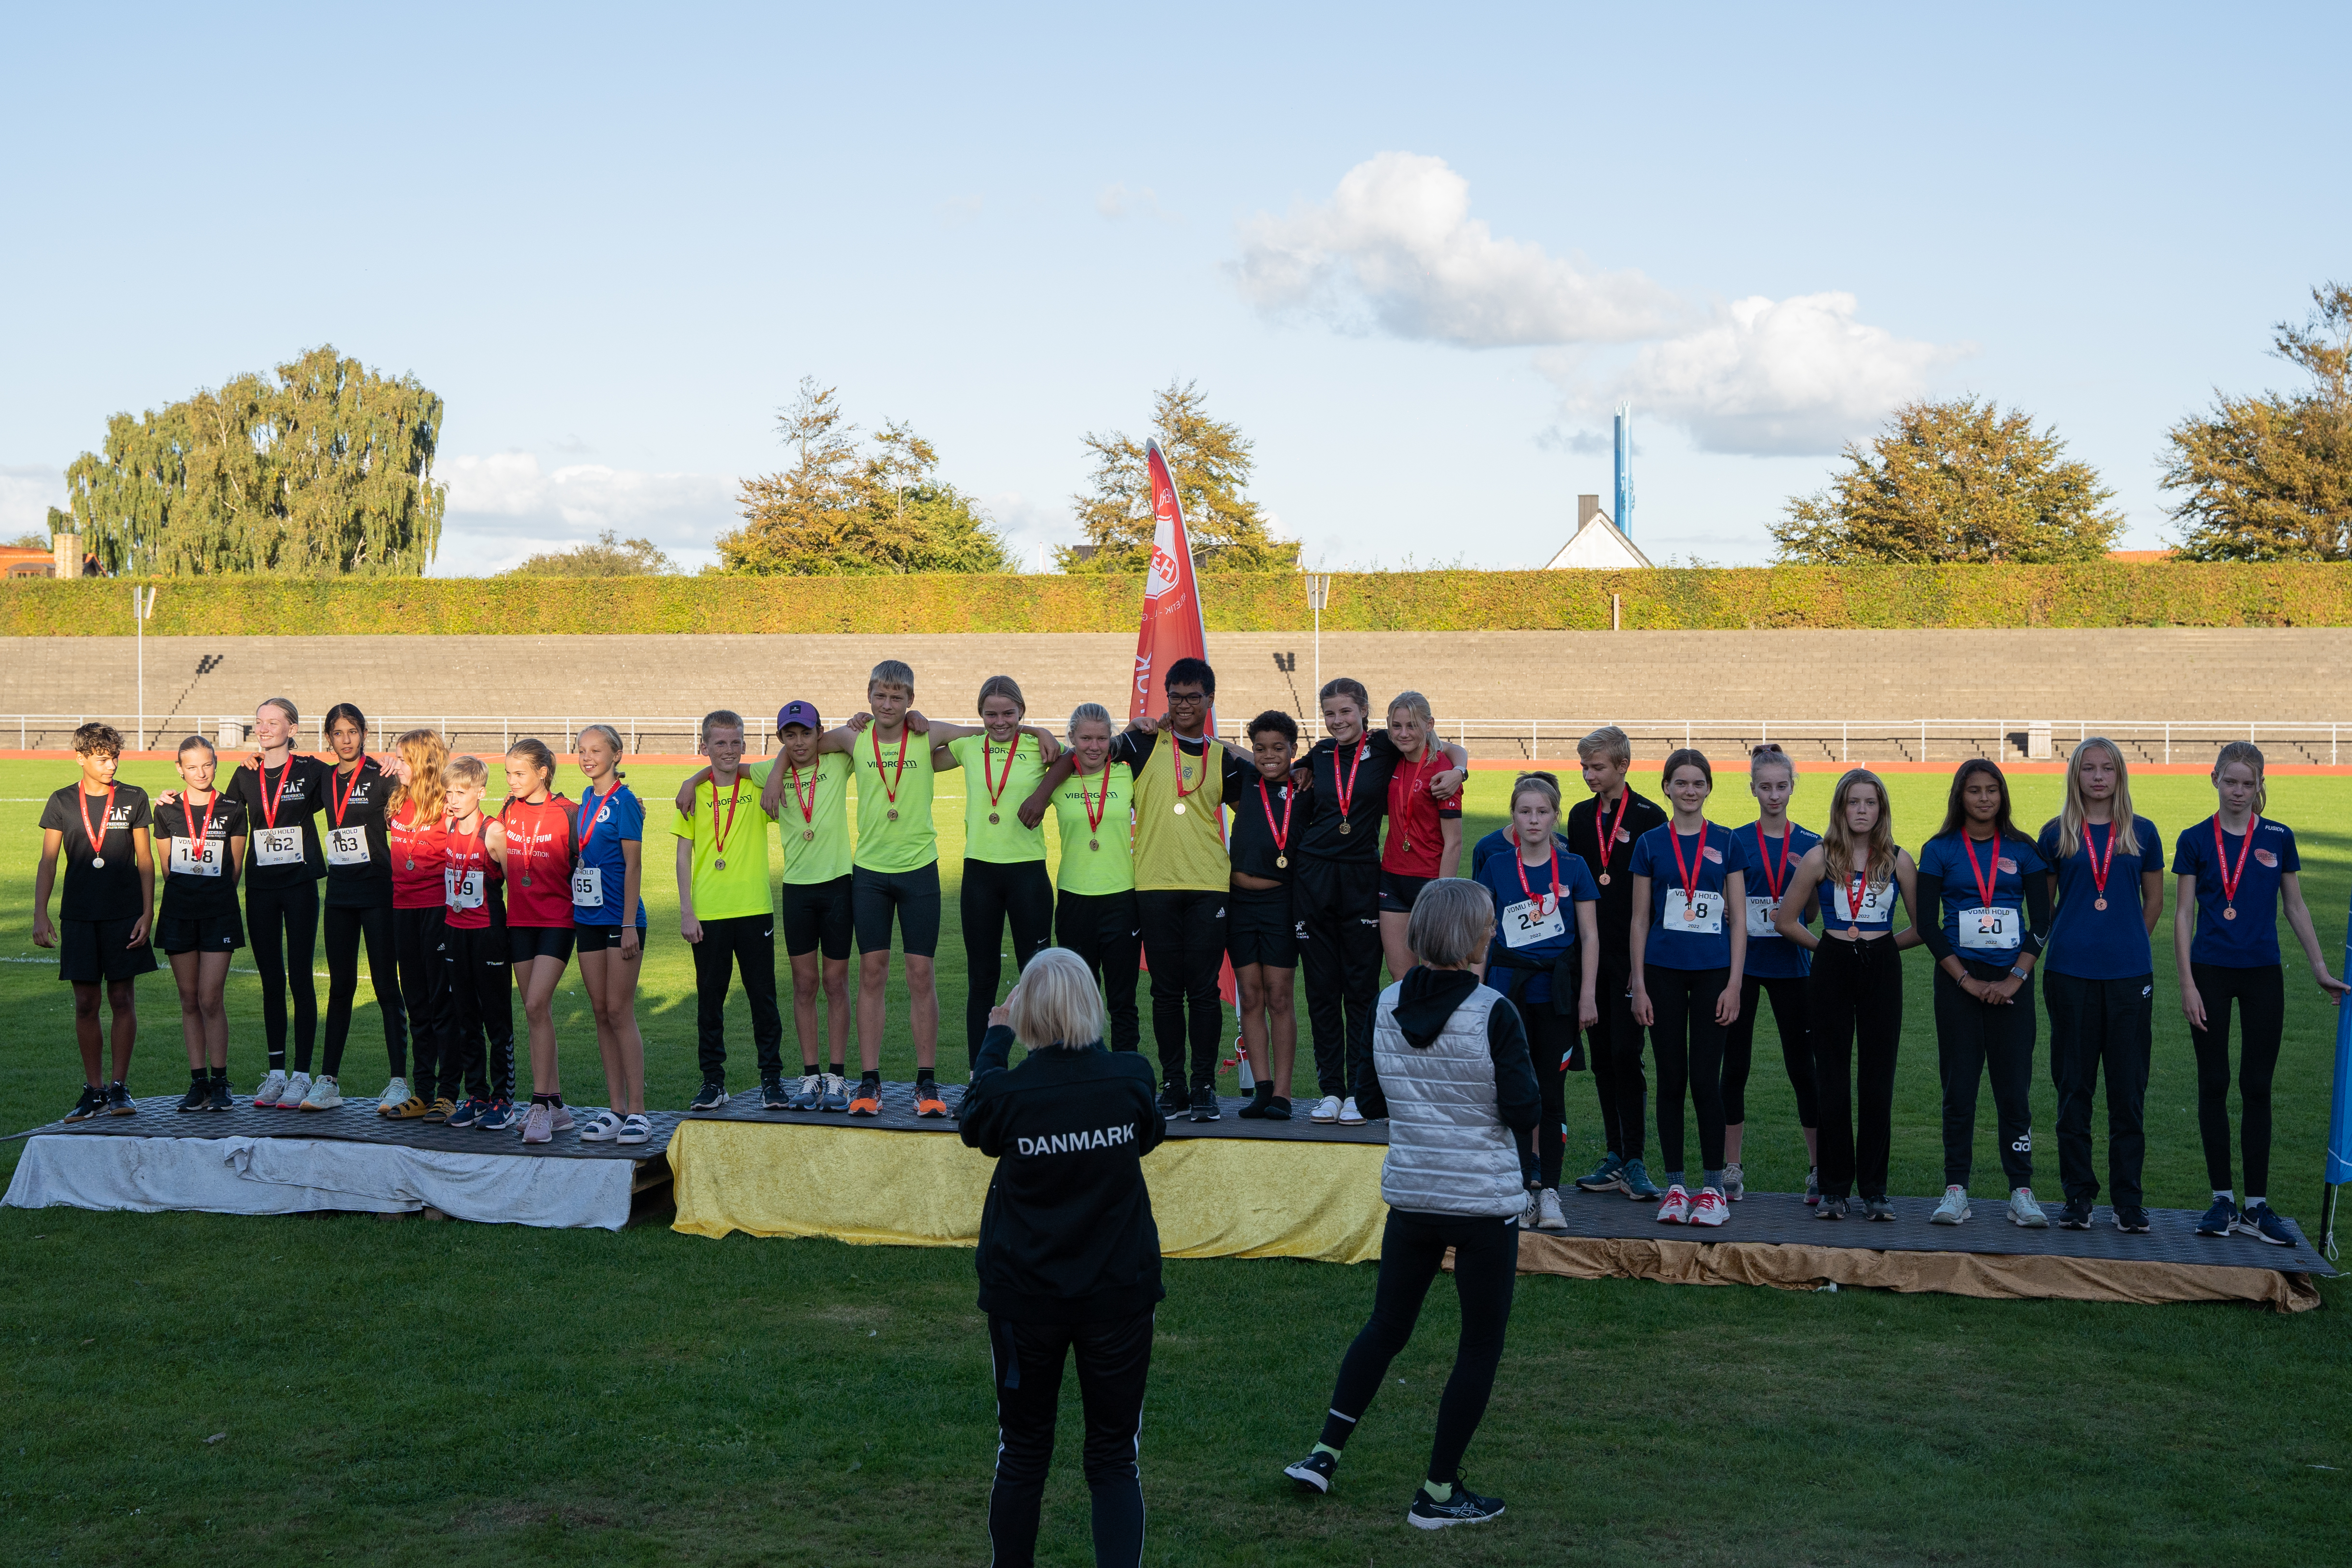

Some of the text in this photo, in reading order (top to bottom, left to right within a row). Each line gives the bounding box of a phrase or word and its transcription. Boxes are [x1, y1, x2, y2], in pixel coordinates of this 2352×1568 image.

[507, 830, 552, 844] KOLDIG FUM
[1800, 830, 1818, 839] FUSION
[264, 837, 293, 852] 162
[333, 838, 358, 852] 163
[573, 879, 593, 893] 155
[1507, 903, 1526, 914] VDMU
[1528, 898, 1547, 907] HOD
[1978, 919, 2002, 934] 20
[1018, 1123, 1134, 1156] DANMARK
